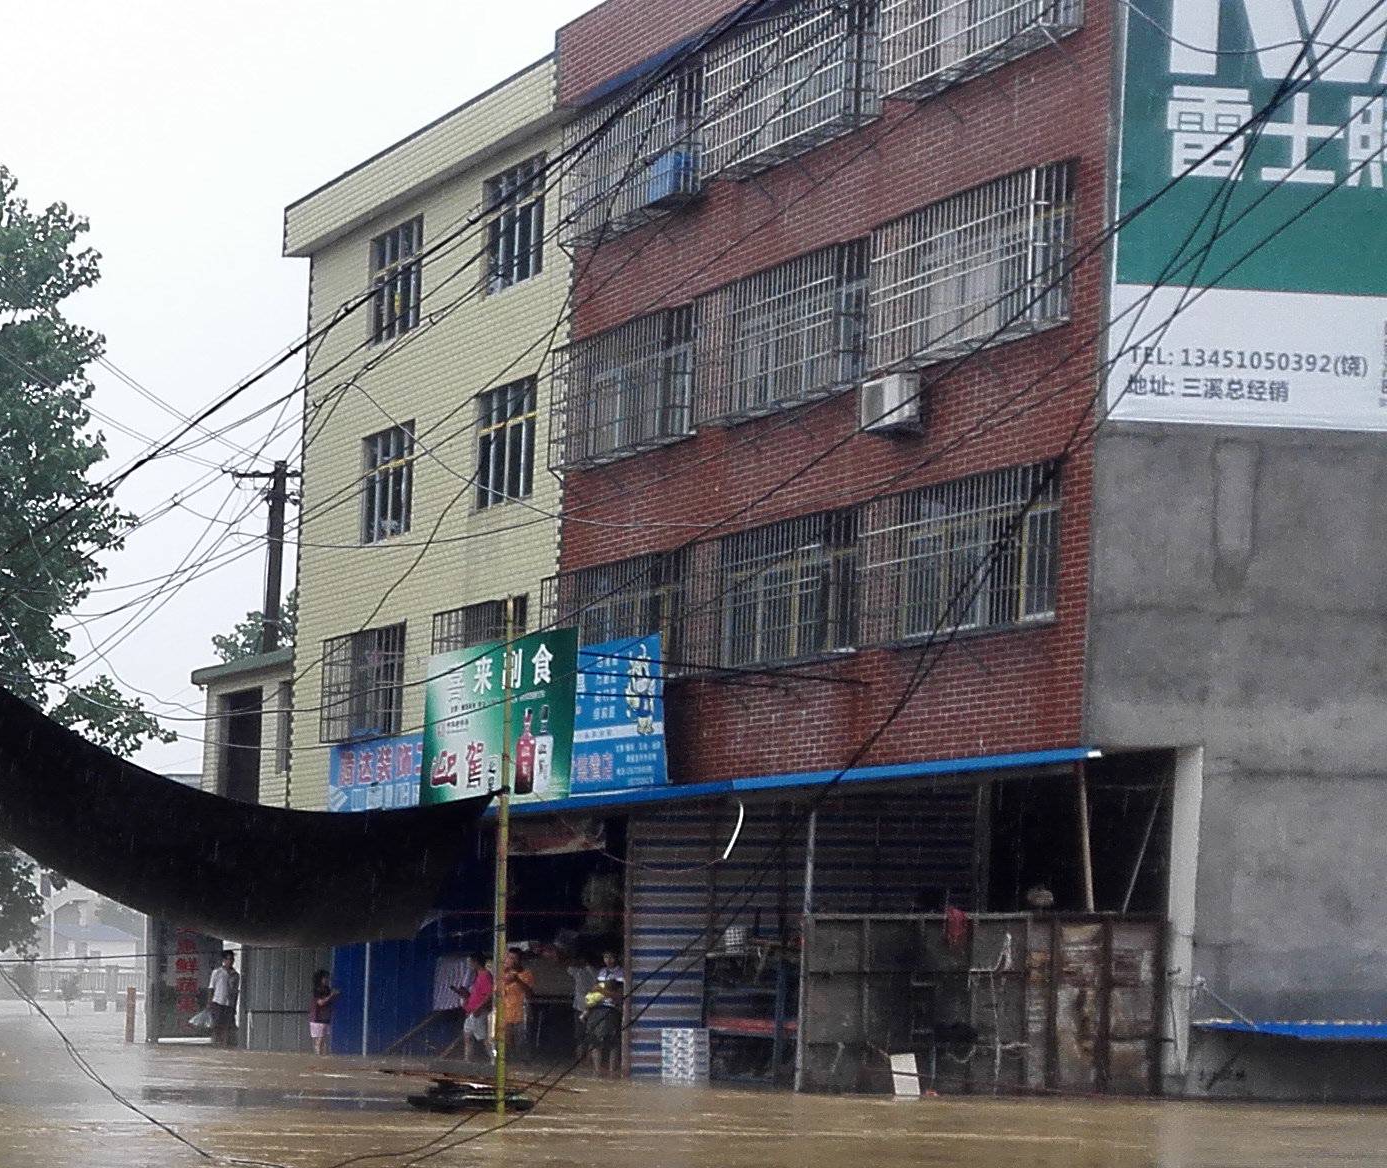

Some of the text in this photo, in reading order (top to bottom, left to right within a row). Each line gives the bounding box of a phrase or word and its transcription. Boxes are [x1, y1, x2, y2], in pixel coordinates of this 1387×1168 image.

[1181, 377, 1290, 403] 三溪总经销
